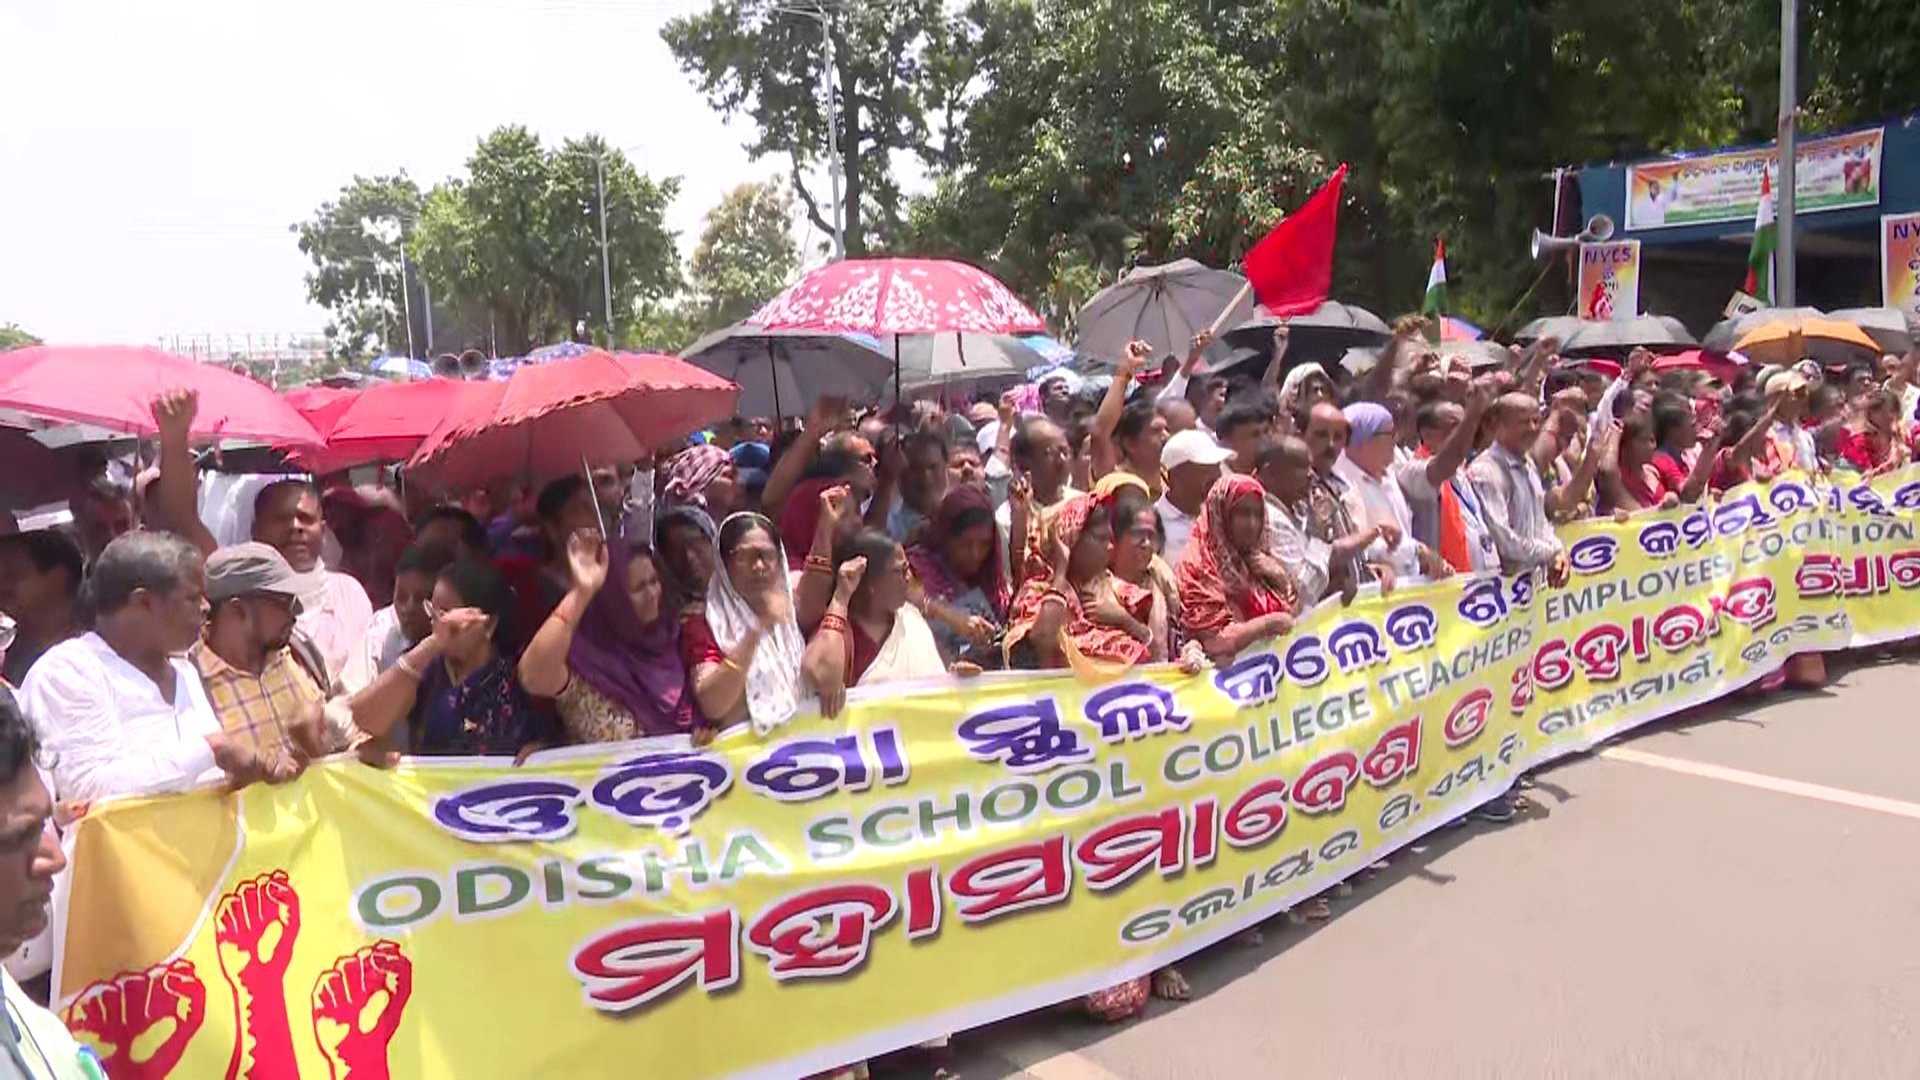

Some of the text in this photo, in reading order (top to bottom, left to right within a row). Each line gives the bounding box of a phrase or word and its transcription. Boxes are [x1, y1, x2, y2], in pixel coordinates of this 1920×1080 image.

[1585, 247, 1631, 264] NYCS
[358, 834, 784, 926] ODISHA
[809, 762, 1140, 857] SCHOOL
[1165, 689, 1368, 779] COLLEGE
[1383, 622, 1532, 707] TEACHERS
[1546, 555, 1731, 623] EMPLOYEES
[436, 731, 904, 837] ଓଡ଼ିଶା
[958, 684, 1187, 766] ସ୍କୁଲ
[1217, 606, 1435, 698] କଲେଜ
[1571, 536, 1616, 569] ଓ
[575, 718, 1421, 1002] ମହାସମାବେଶ
[1445, 688, 1492, 743] ଓ
